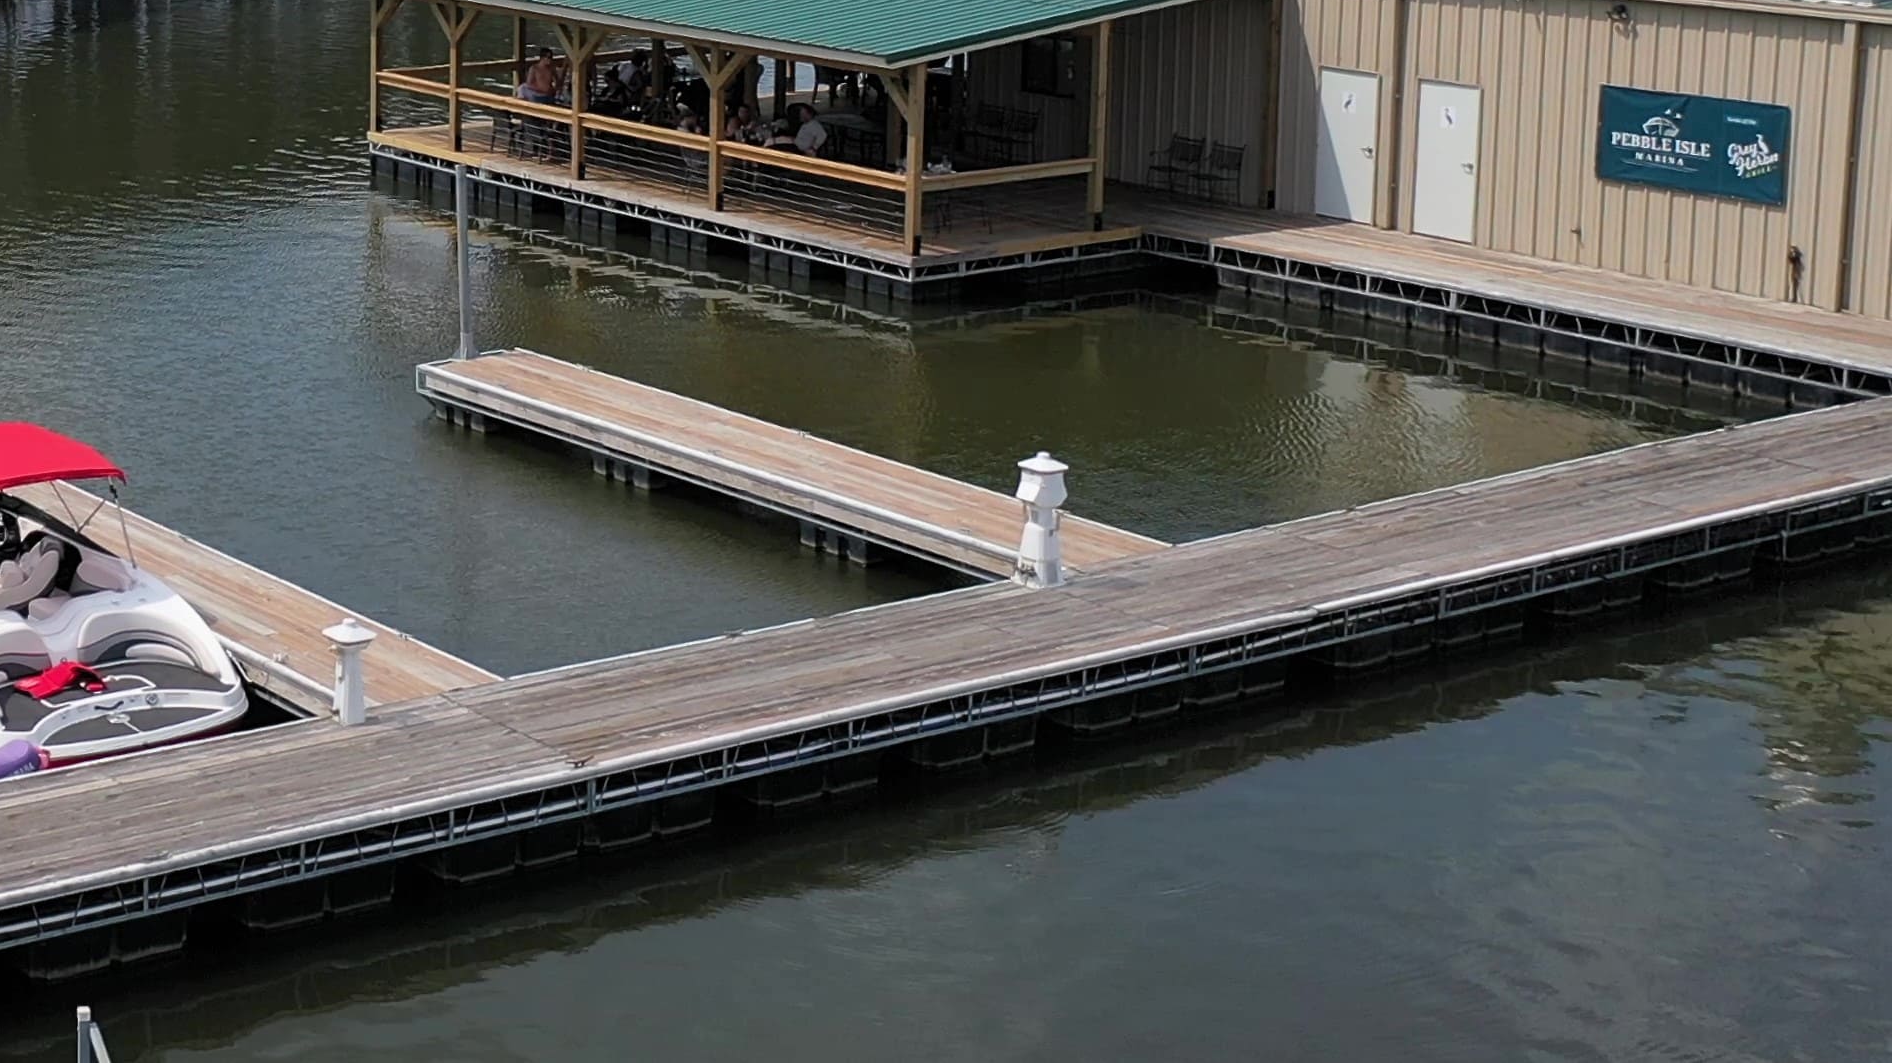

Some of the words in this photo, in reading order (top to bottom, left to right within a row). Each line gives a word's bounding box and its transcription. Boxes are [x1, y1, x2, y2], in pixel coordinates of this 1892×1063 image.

[1611, 131, 1672, 152] PEBBLE
[1674, 139, 1711, 157] ISLE
[1635, 152, 1685, 166] MARINA
